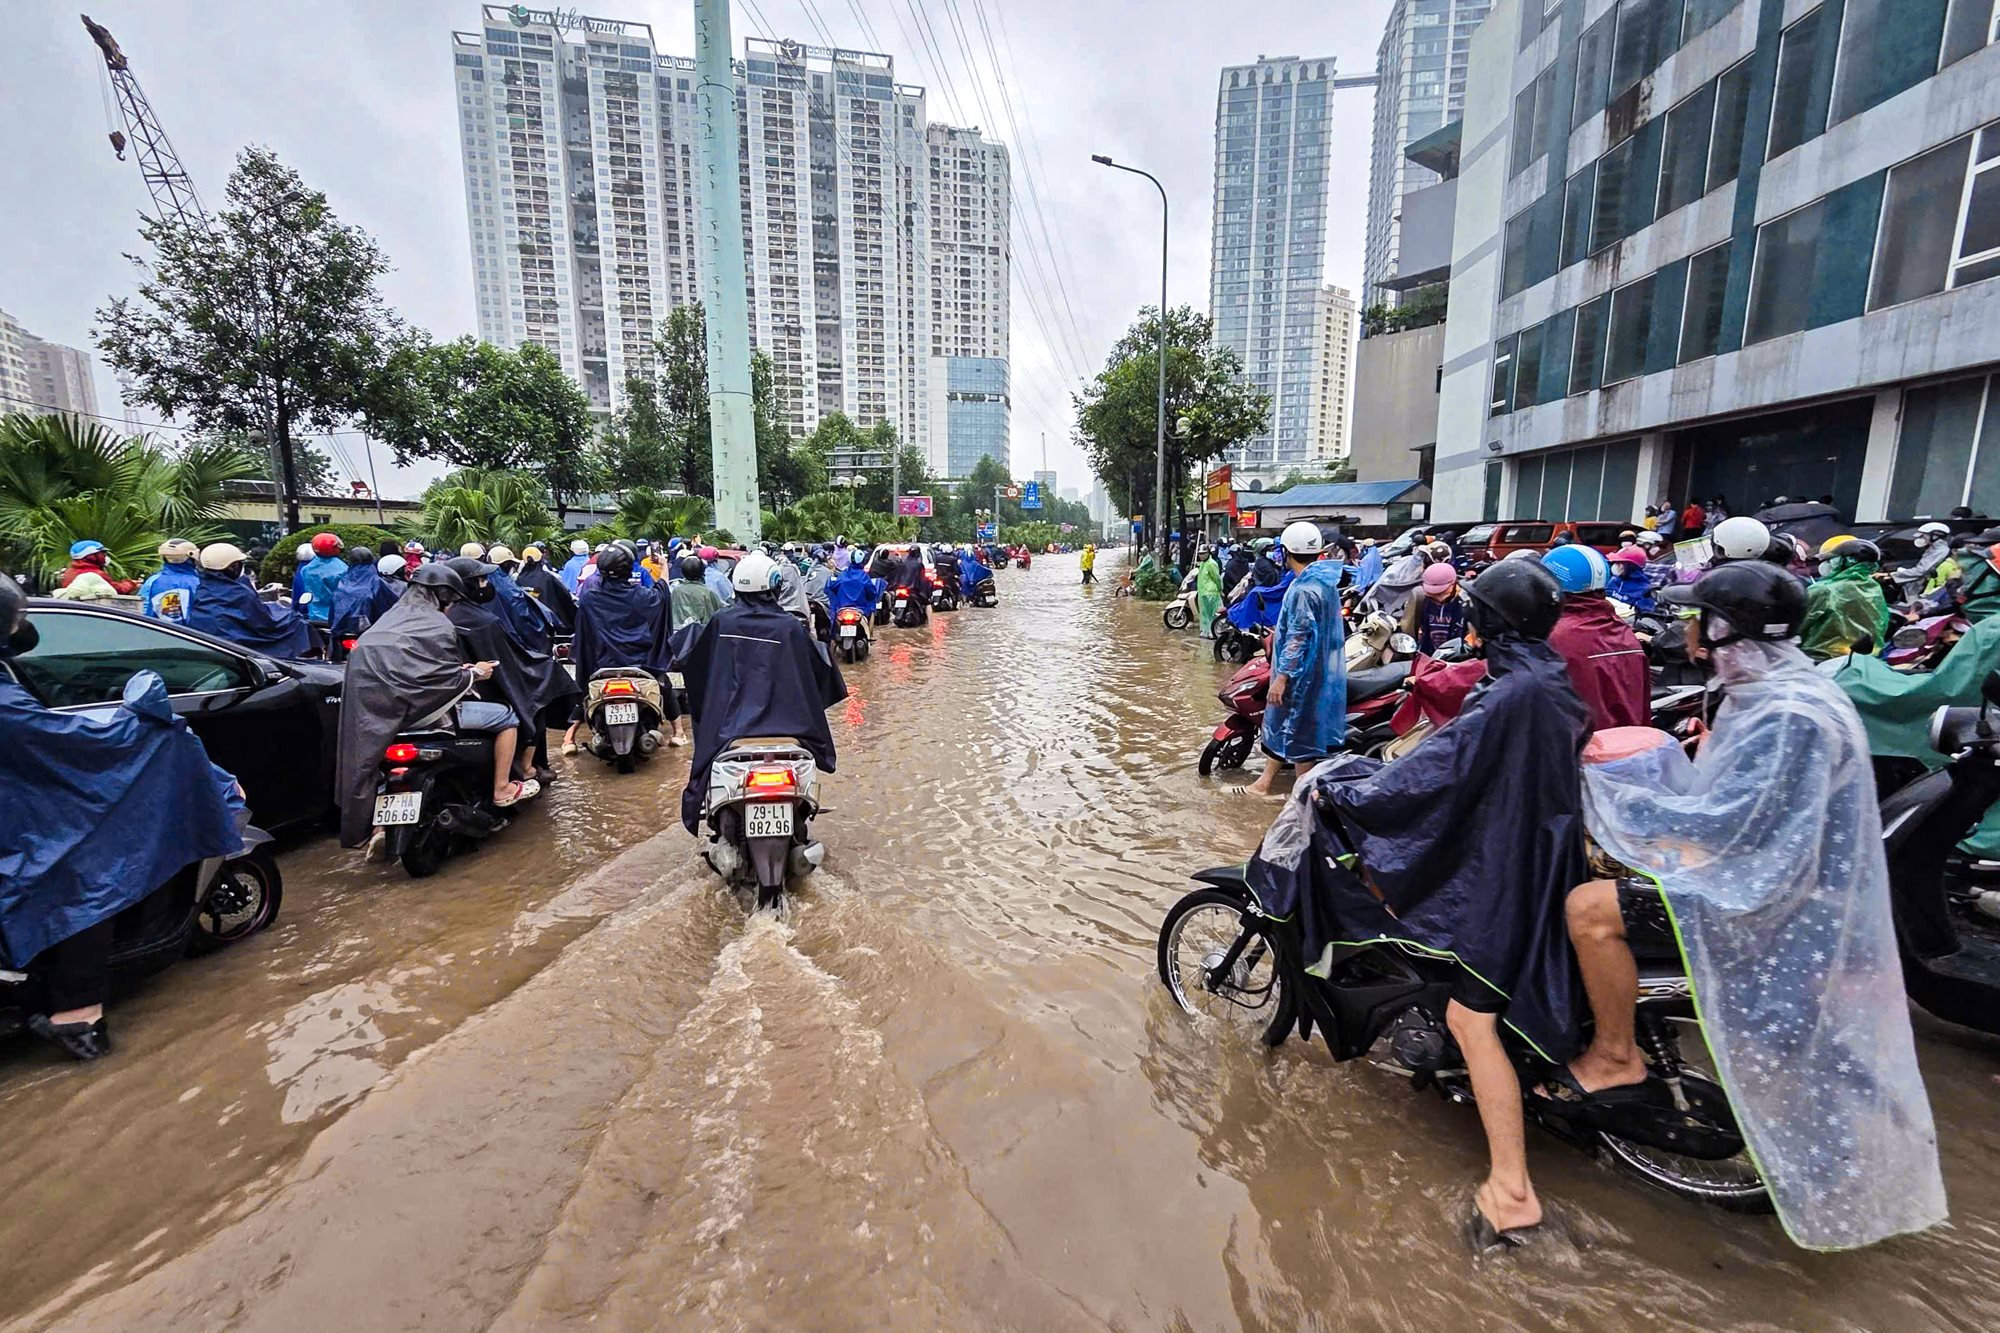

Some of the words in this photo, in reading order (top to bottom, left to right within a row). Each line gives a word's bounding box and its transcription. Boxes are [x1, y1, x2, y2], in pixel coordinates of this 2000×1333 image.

[610, 704, 632, 714] 29-T1
[608, 712, 636, 724] 732.28
[382, 795, 414, 809] 37-HA
[376, 808, 416, 823] 506.69
[753, 805, 785, 820] 29-L1
[749, 820, 790, 835] 982.96
